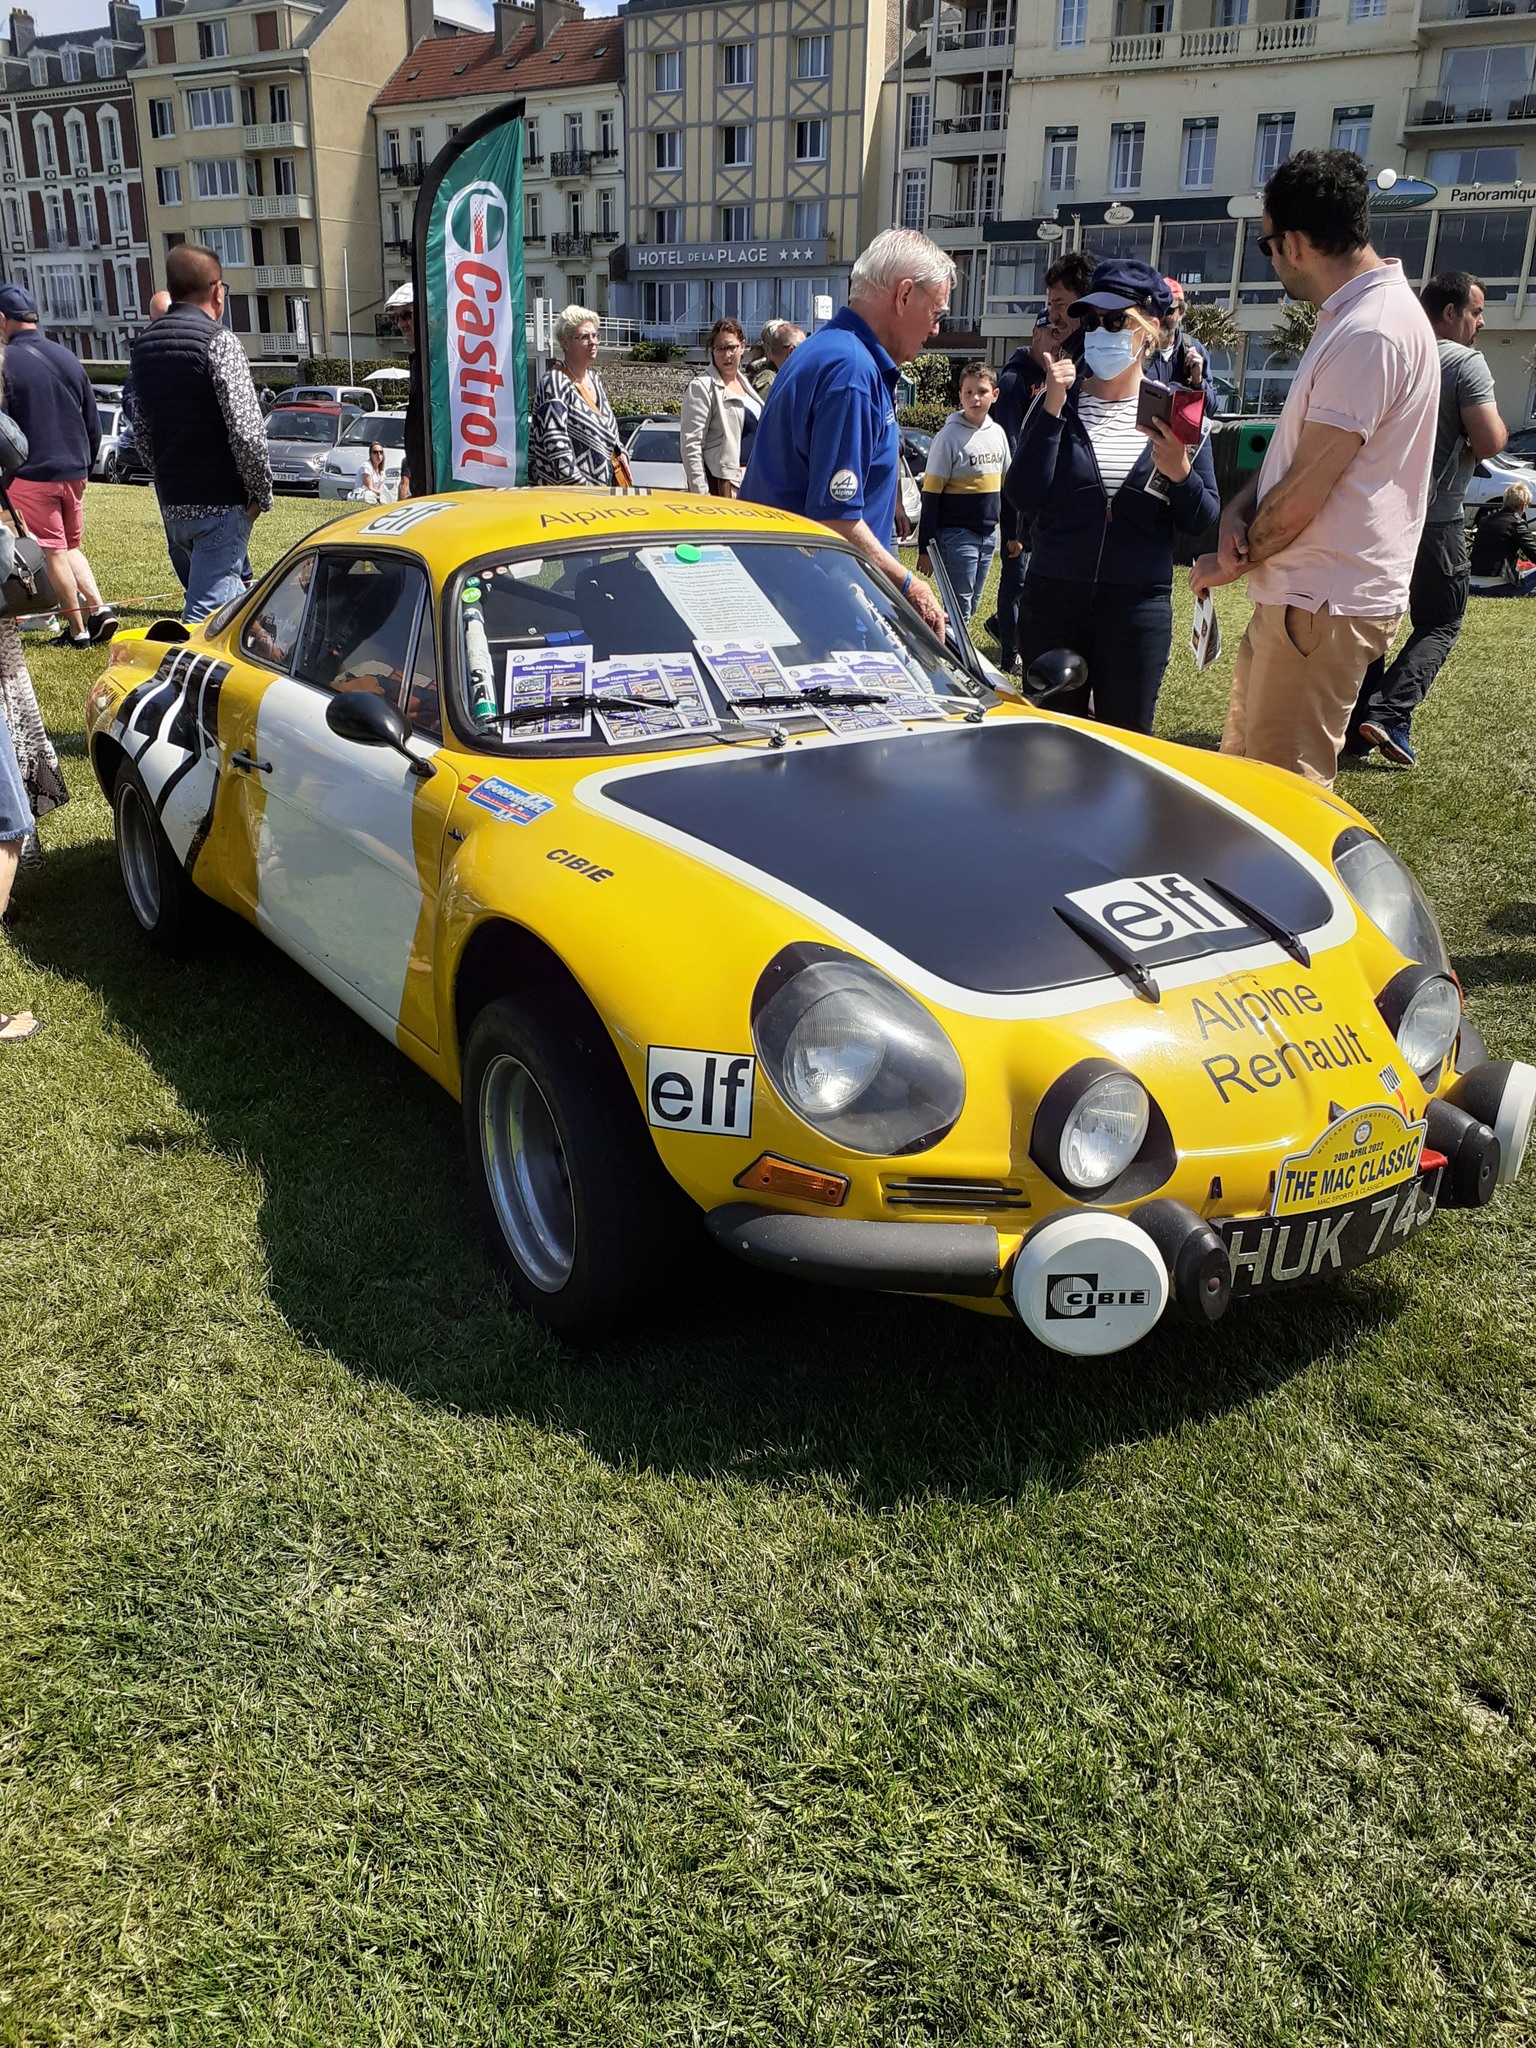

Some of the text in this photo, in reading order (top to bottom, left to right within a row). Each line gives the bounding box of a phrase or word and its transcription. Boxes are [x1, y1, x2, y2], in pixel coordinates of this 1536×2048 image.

[1451, 188, 1536, 203] Panoramiqu
[638, 248, 768, 266] HOTEL DE LA PLAGE
[454, 259, 508, 469] Castrol
[834, 487, 853, 497] Alpine
[367, 502, 459, 531] elf
[540, 503, 795, 529] Alpine Renault
[1102, 876, 1228, 942] elf
[1191, 980, 1323, 1041] Alpine
[1201, 1023, 1373, 1104] Renault
[1378, 1063, 1401, 1093] TOW
[651, 1057, 750, 1128] elf
[1317, 1124, 1347, 1154] MIDLAND
[1333, 1141, 1384, 1163] 24th APRIL 2022
[1284, 1135, 1420, 1203] THE MAC CLASSIC
[1316, 1195, 1331, 1206] MAC
[1331, 1190, 1354, 1203] SPORTS
[1359, 1181, 1385, 1197] CLASSICS
[1230, 1211, 1355, 1287] HUK
